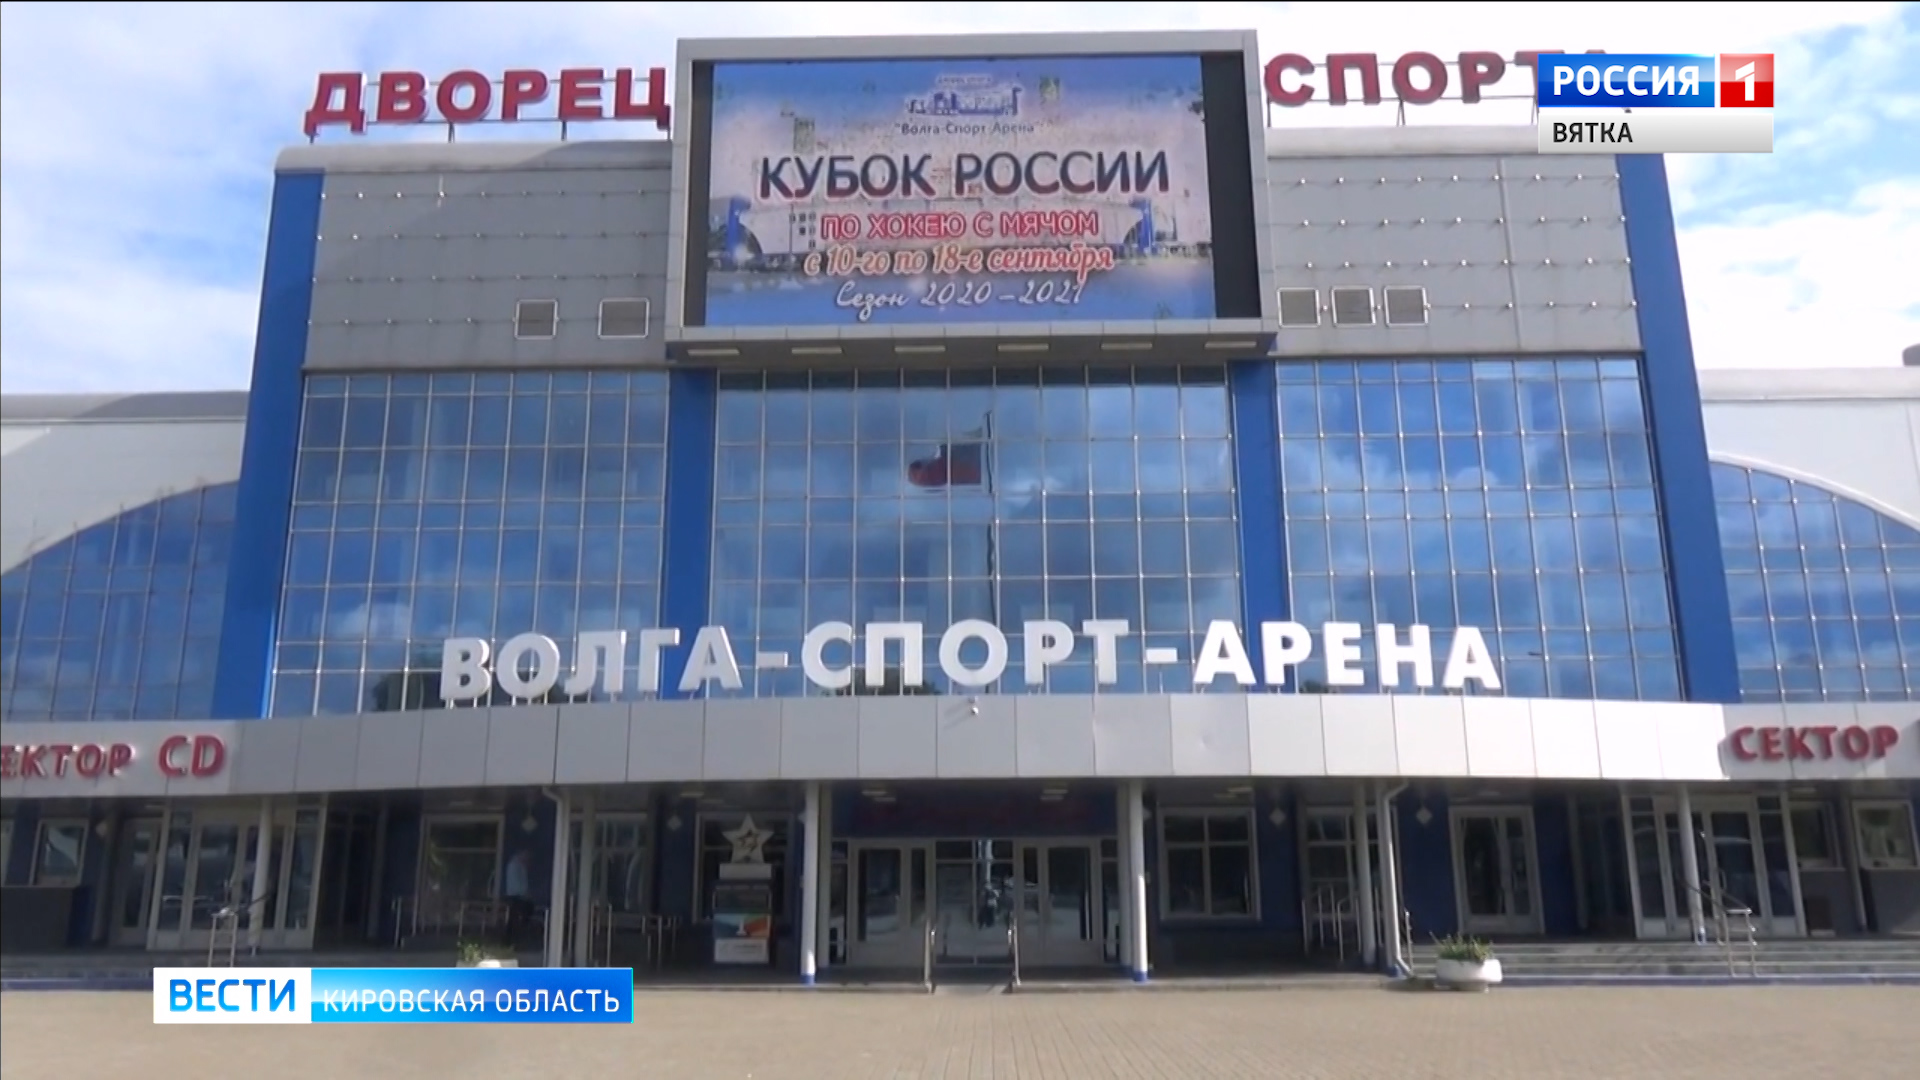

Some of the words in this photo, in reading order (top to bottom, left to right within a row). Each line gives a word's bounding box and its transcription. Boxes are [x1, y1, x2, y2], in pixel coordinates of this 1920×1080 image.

[304, 67, 671, 136] ДВОРЕЦ
[1264, 49, 1632, 113] СПОРТ
[760, 154, 936, 200] КУБОК
[953, 150, 1170, 195] РОССИИ
[820, 214, 862, 240] ПО
[867, 212, 967, 239] ХОКЕЮ
[973, 213, 994, 237] С
[1001, 211, 1099, 237] МЯЧОМ
[804, 257, 820, 277] с
[825, 246, 891, 277] 10-го
[895, 251, 928, 275] по
[931, 244, 984, 273] 18-е
[987, 242, 1115, 284] сентября
[836, 281, 907, 322] Сезон
[921, 281, 993, 306] 2020
[158, 735, 226, 777] CD
[1731, 725, 1898, 760] СЕКТОР
